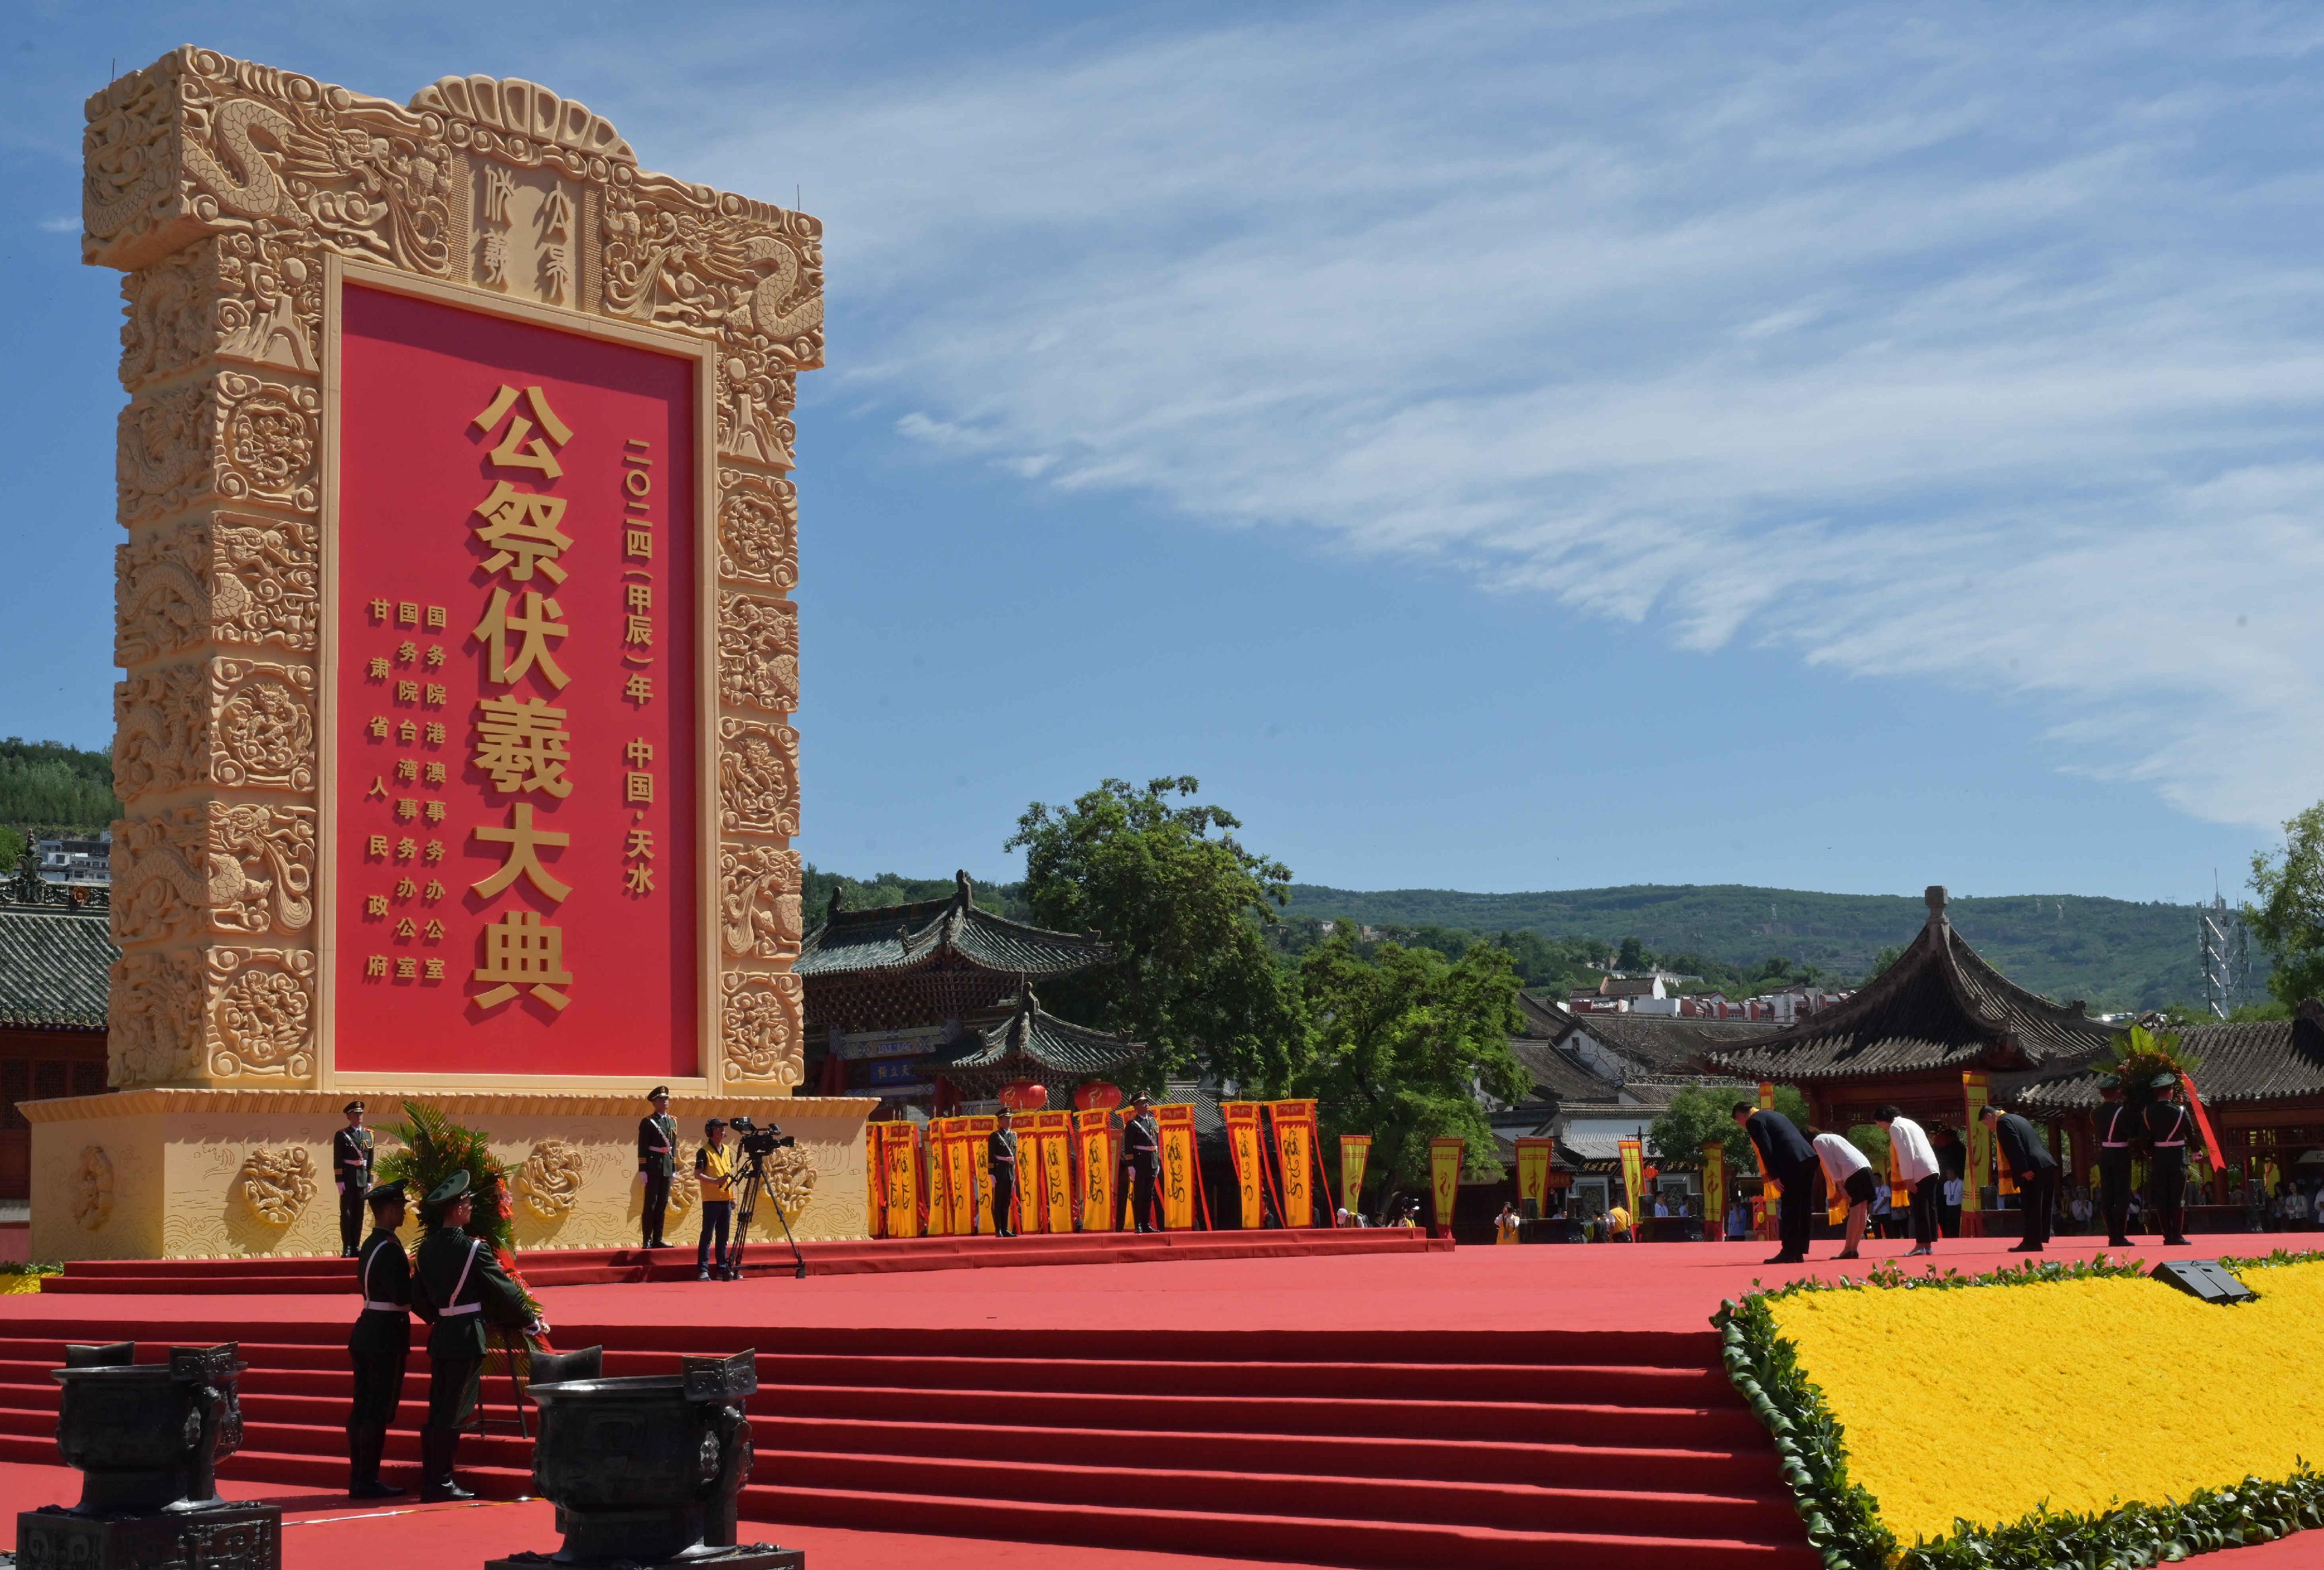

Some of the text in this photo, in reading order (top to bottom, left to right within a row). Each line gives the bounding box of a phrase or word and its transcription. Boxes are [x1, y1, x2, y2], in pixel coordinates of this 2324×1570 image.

[367, 598, 391, 977] 甘肃省人民政府
[396, 602, 419, 978] 国务院台湾事务办公室
[425, 605, 447, 980] 国务院港澳事务办公室
[470, 383, 574, 1011] 公祭伏羲大典
